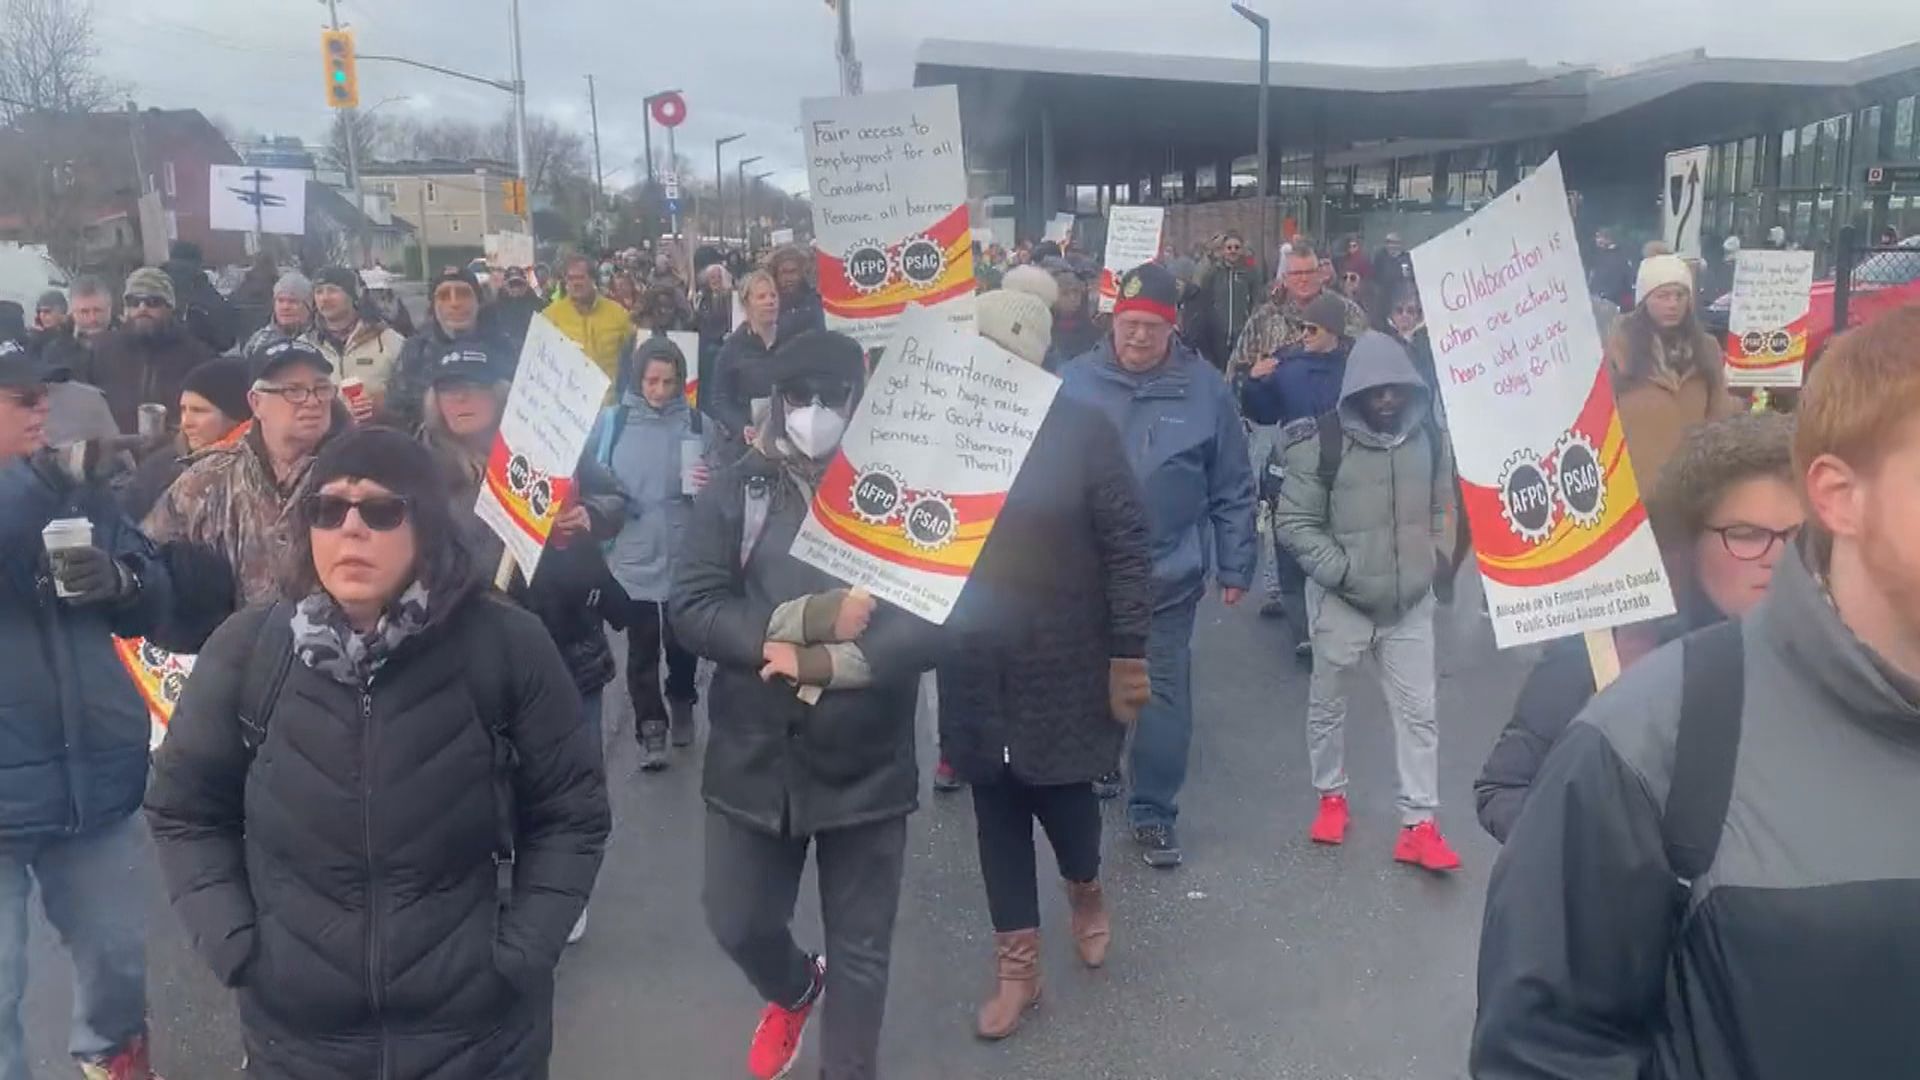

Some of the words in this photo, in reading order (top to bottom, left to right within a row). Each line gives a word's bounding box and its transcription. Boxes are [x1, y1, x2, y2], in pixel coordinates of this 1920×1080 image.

[813, 120, 850, 146] Fair
[857, 126, 903, 140] access
[910, 113, 929, 135] to
[814, 143, 892, 174] employment
[902, 142, 923, 160] for
[933, 141, 952, 155] all
[817, 169, 891, 197] Canadians!
[823, 207, 872, 225] Remove
[880, 204, 897, 219] all
[853, 259, 885, 277] AFPC
[905, 253, 938, 270] PSAC
[1441, 235, 1543, 311] Collaboration
[1440, 324, 1478, 353] when
[1487, 312, 1512, 331] one
[1515, 277, 1568, 317] actually
[1525, 333, 1544, 351] we
[1545, 320, 1567, 341] are
[900, 336, 1018, 393] Parlimentarians
[872, 399, 893, 416] but
[884, 375, 908, 395] got
[920, 378, 946, 397] two
[957, 385, 985, 409] huge
[1511, 483, 1546, 514] AFPC
[1564, 464, 1597, 496] PSAC
[858, 482, 894, 509] AFPC
[911, 507, 948, 536] PSAC
[1626, 568, 1661, 587] Canada
[1515, 616, 1546, 634] Public
[1616, 594, 1651, 613] Canada
